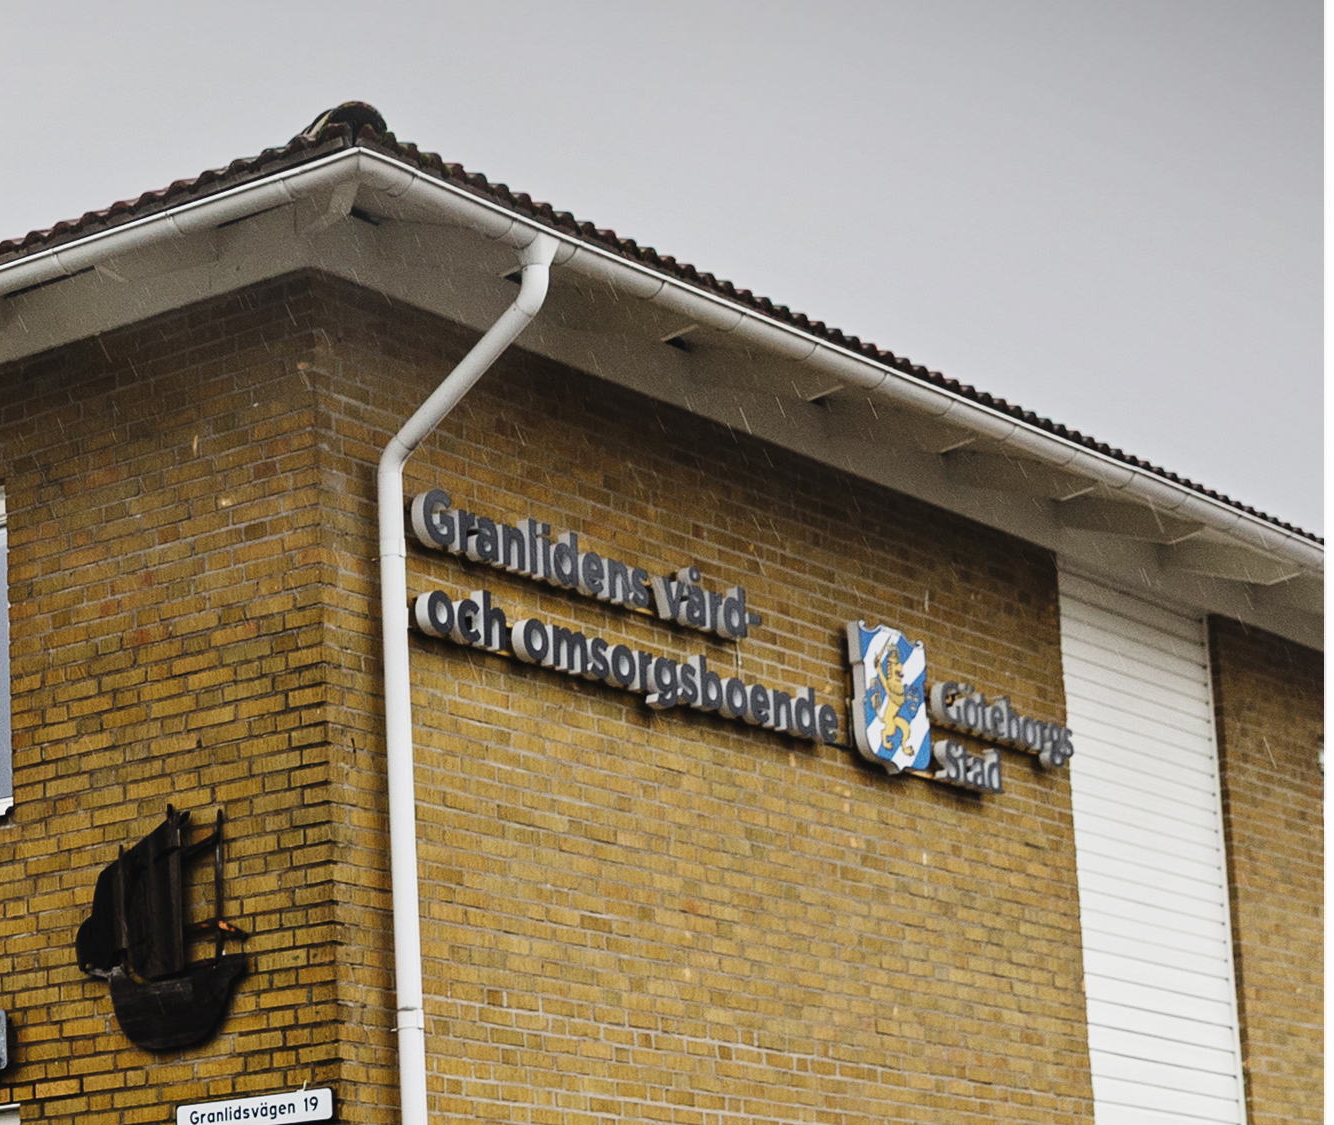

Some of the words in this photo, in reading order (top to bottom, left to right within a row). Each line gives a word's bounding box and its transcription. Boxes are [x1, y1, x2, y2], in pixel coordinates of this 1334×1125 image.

[412, 489, 649, 608] Granlidens
[652, 565, 762, 639] vård-
[415, 590, 506, 651] och
[511, 617, 839, 744] omsorgsboende
[931, 681, 1074, 767] Göteborgs
[934, 739, 1004, 794] Stad
[189, 1101, 296, 1125] Granlidsvägen
[303, 1095, 319, 1113] 19
